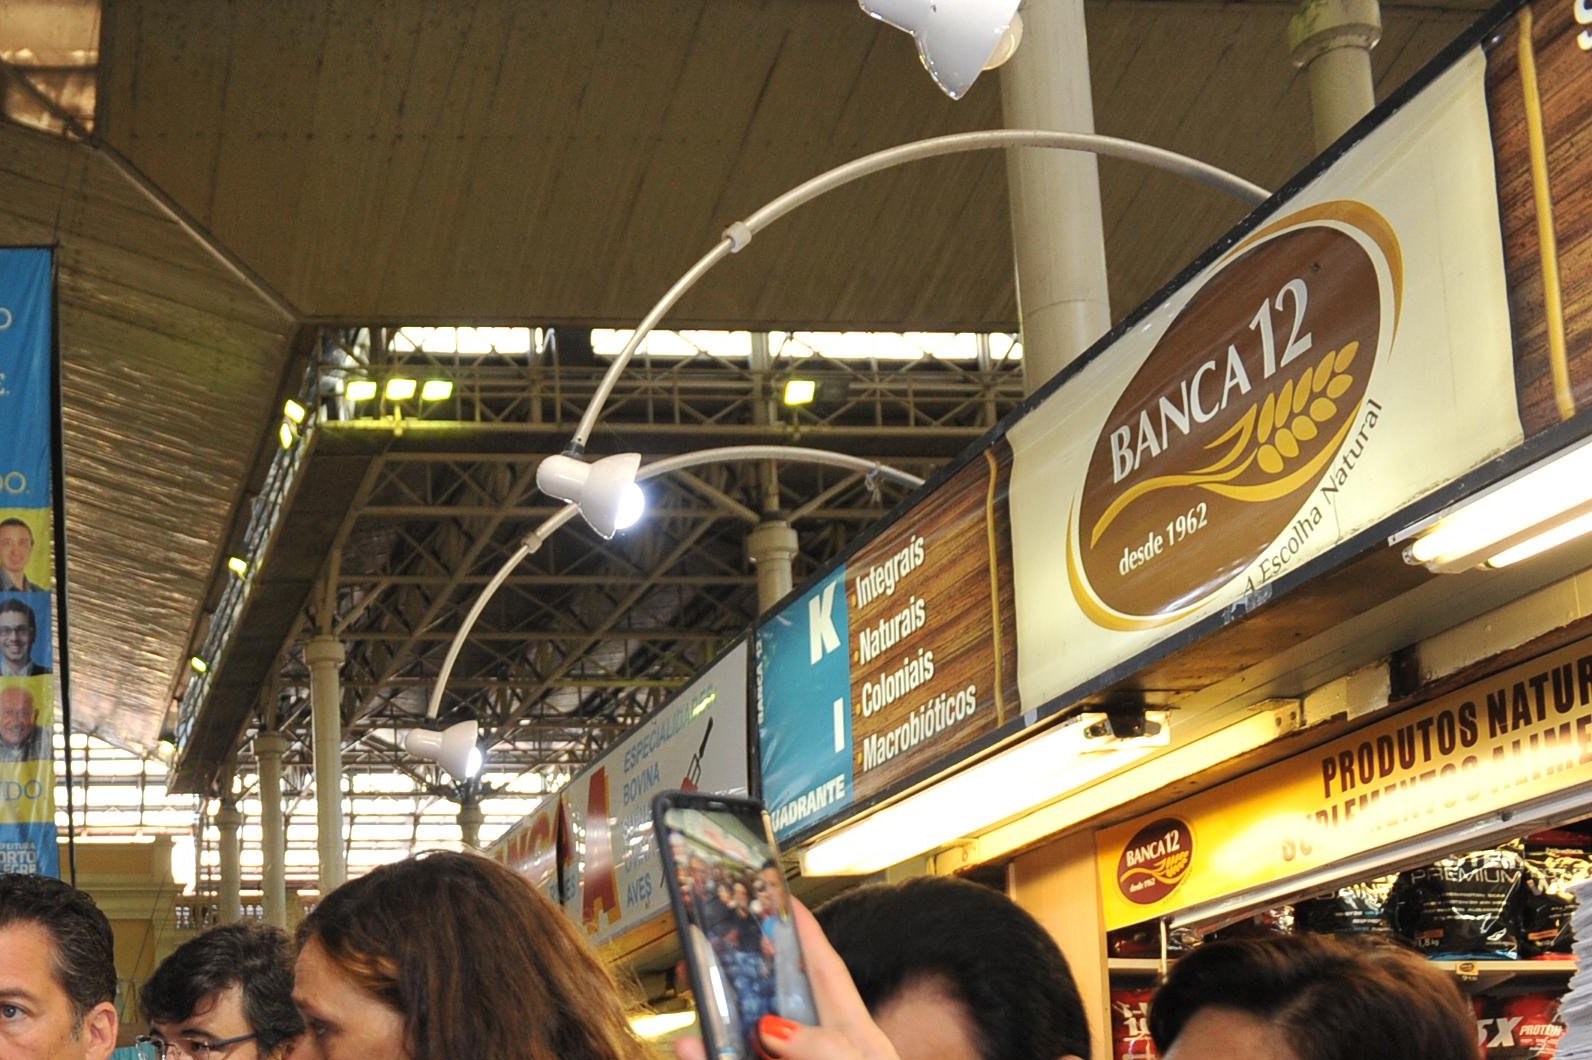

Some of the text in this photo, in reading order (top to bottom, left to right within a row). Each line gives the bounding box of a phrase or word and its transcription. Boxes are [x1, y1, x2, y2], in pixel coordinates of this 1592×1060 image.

[1110, 278, 1313, 484] BANCA 12
[1258, 505, 1323, 585] Escolha
[1321, 398, 1383, 504] Natural
[855, 534, 925, 609] Integrais
[1118, 502, 1209, 577] desde 1962
[809, 580, 841, 665] K
[859, 596, 926, 665] Naturais
[861, 648, 935, 717] Coloniais
[863, 685, 977, 772] Macrobióticos
[1322, 701, 1479, 799] PRODUTOS
[623, 762, 661, 806] BOVINA
[771, 774, 846, 833] UADRANTE
[1126, 829, 1181, 867] BANCA 12
[1411, 868, 1523, 885] PREMIUM
[627, 871, 653, 907] AVES
